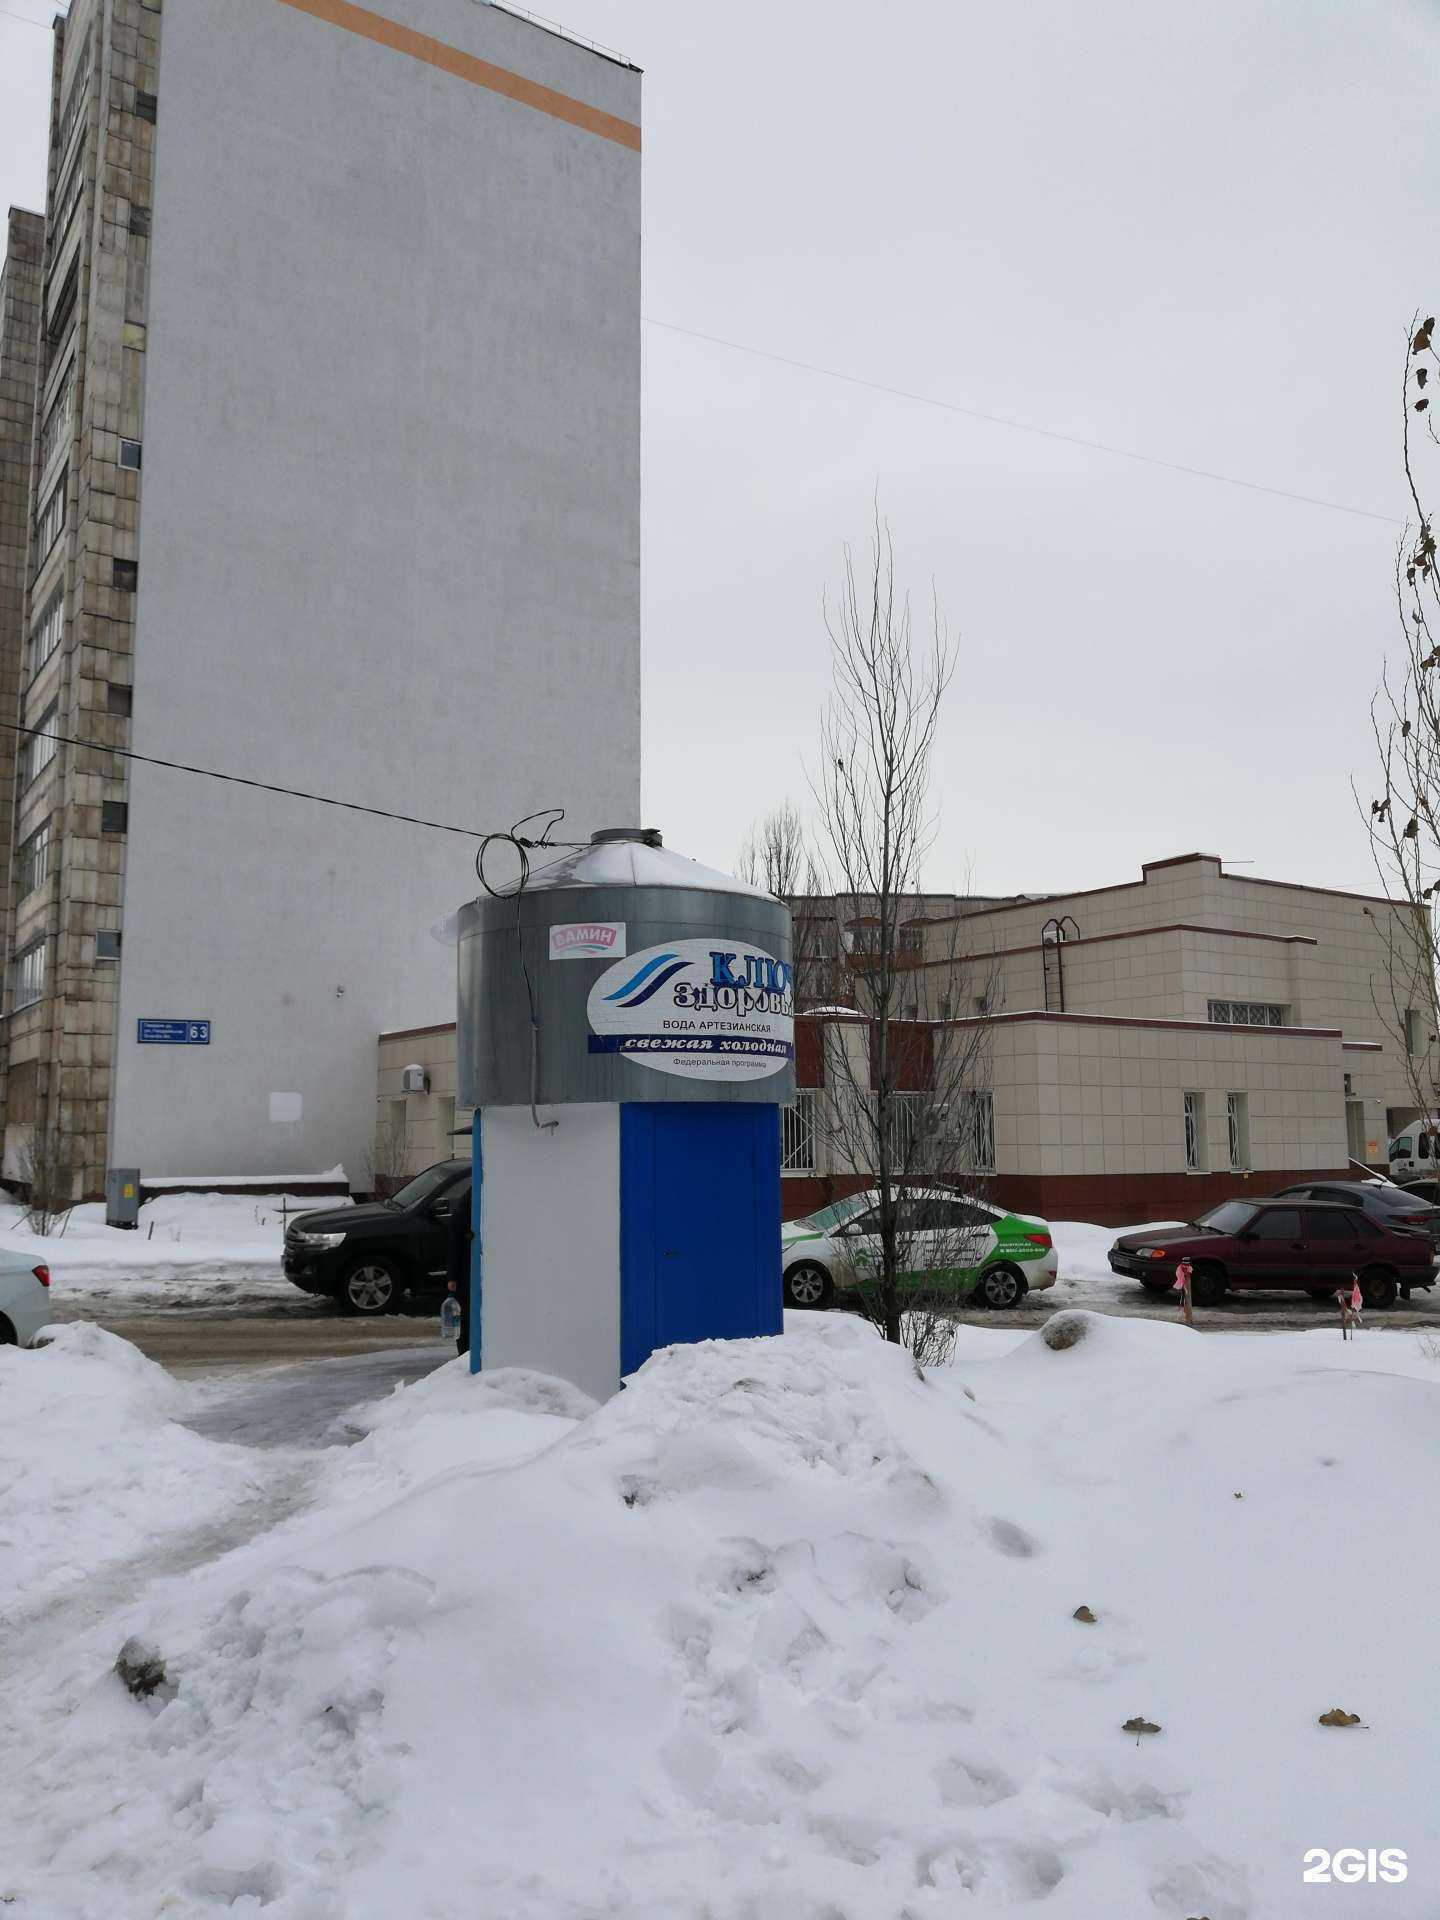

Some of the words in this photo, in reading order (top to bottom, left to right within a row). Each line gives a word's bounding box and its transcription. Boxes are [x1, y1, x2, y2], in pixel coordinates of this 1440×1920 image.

[190, 1026, 208, 1039] 63
[663, 1020, 696, 1031] ВОДА
[699, 1021, 771, 1033] АРТЕЗИАНСКАЯ
[623, 1038, 713, 1050] свежая
[719, 1039, 787, 1054] холодная
[673, 1058, 730, 1067] Федеральная
